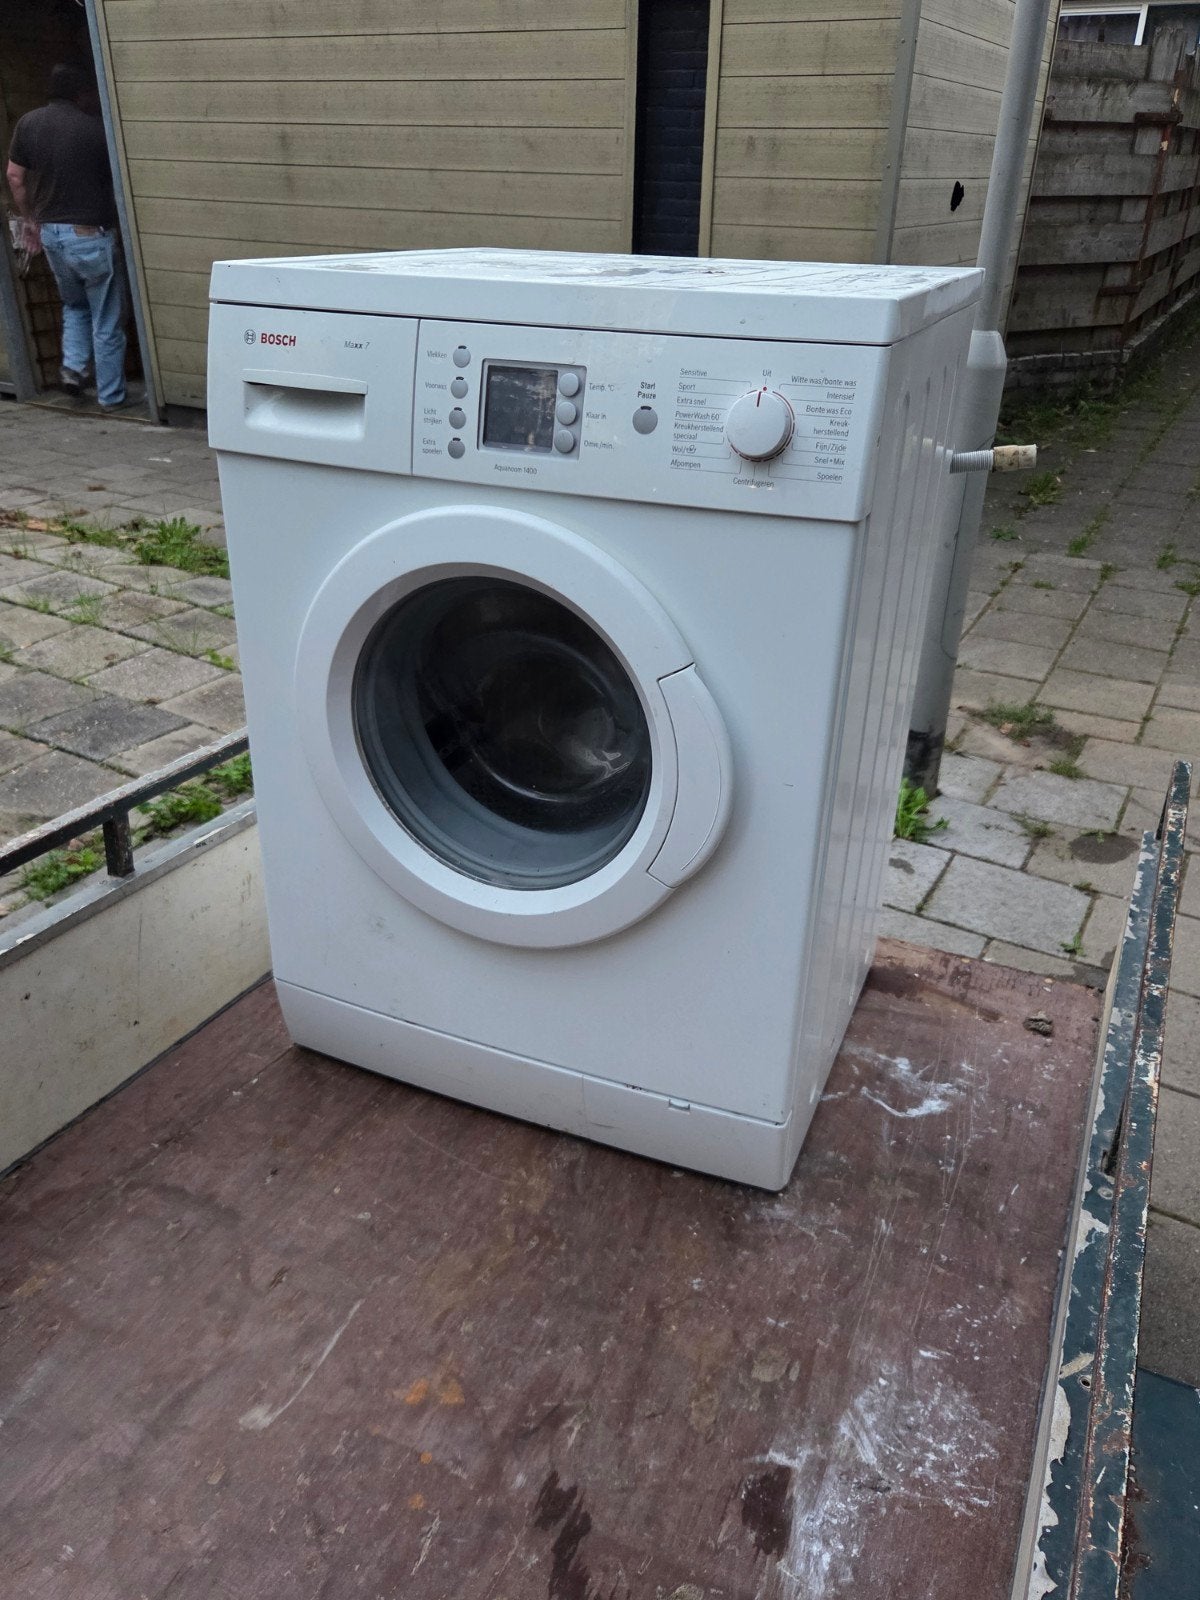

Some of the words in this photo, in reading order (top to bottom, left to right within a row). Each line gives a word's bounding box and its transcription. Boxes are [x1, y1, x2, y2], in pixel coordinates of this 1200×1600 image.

[260, 332, 297, 347] BOSCH
[344, 340, 363, 349] Maxx
[680, 367, 708, 377] Sensitive
[762, 369, 772, 377] Uit
[640, 381, 656, 390] Start
[678, 382, 696, 391] Sport
[809, 378, 843, 386] was/bonte
[637, 390, 657, 400] Pauze
[826, 392, 855, 400] Intensief
[676, 396, 692, 404] Extra
[692, 397, 706, 405] snel
[805, 405, 825, 413] Bonte
[826, 407, 840, 415] was
[840, 408, 853, 416] Eco
[585, 412, 600, 420] Klaar
[675, 411, 710, 420] PowerWash
[673, 422, 724, 432] Kreukherstellend
[829, 419, 850, 427] Kreuk-
[673, 432, 698, 440] speciaal
[813, 428, 849, 437] herstellend
[422, 438, 436, 446] Extra
[815, 442, 847, 452] Fijn/Zijde
[670, 459, 701, 468] Afpompen
[523, 467, 538, 475] 1400
[816, 473, 843, 481] Spoelen
[733, 477, 774, 487] Centrifugeren
